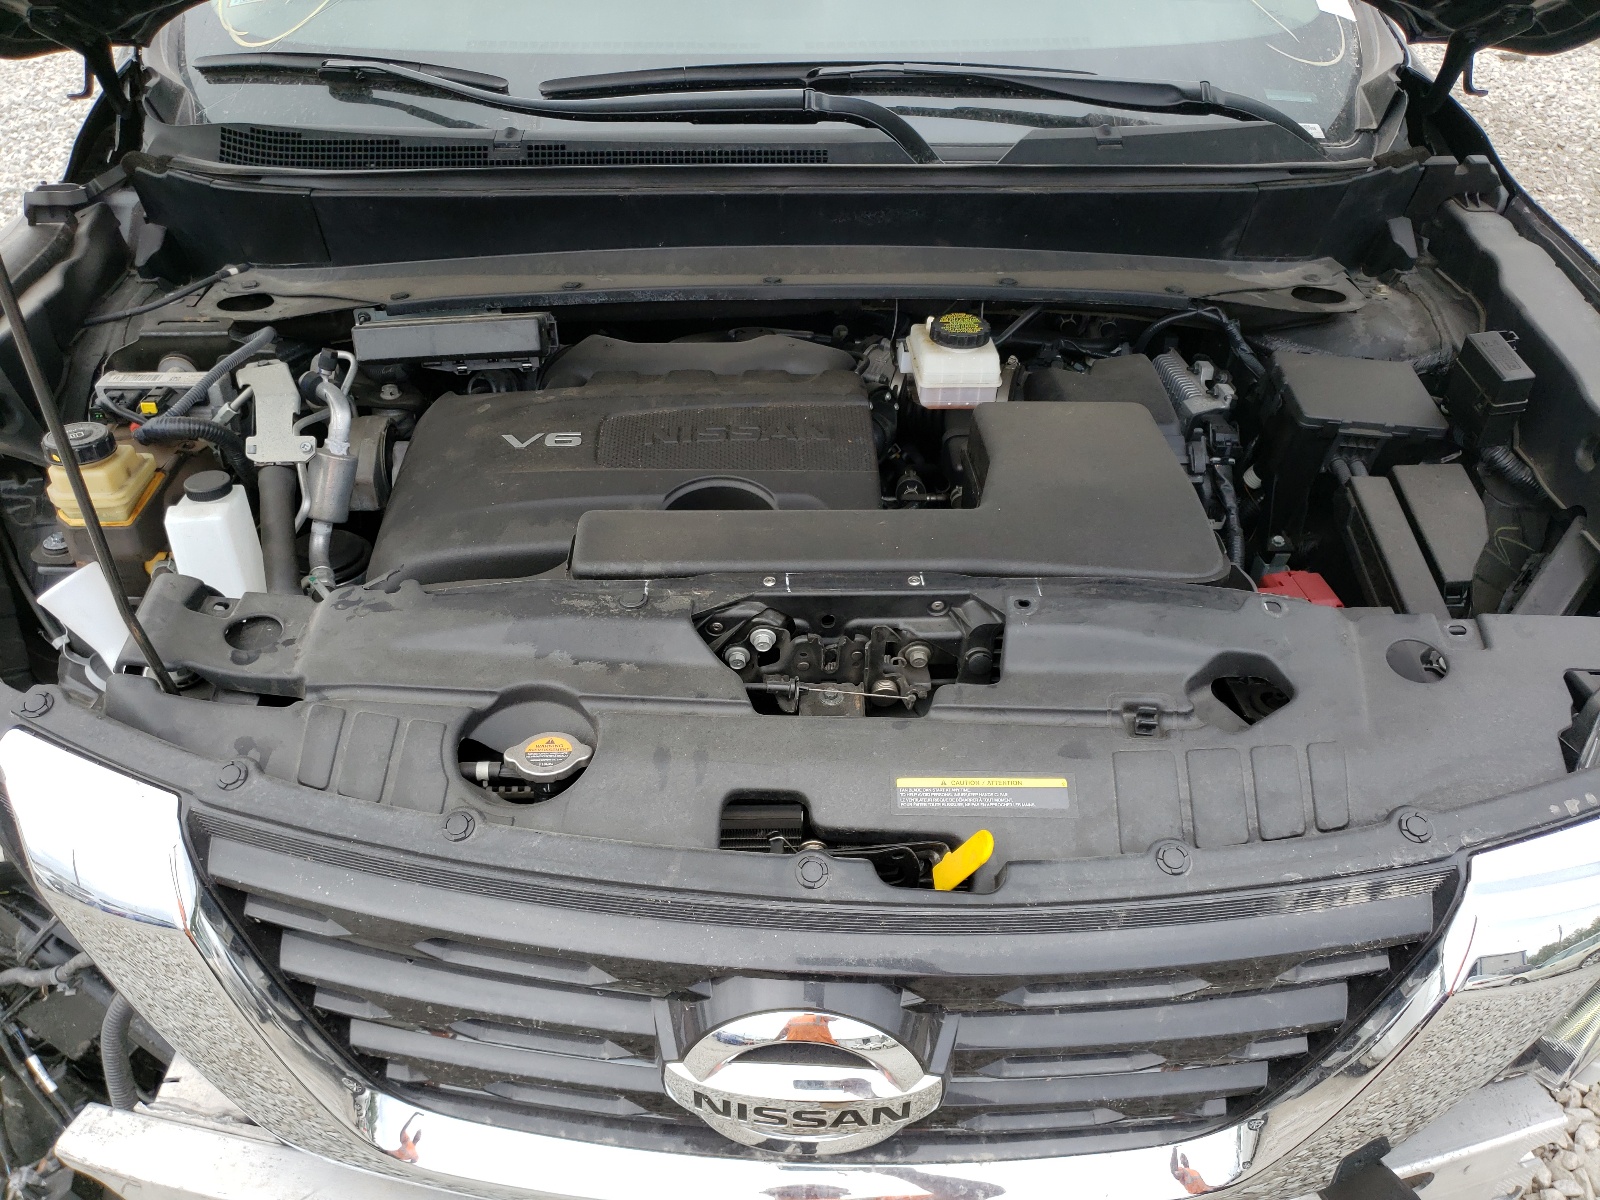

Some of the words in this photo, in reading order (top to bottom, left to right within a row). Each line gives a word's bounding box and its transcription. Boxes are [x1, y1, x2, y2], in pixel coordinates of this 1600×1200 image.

[501, 431, 582, 449] V6
[643, 425, 832, 447] NISSAN
[693, 1090, 912, 1129] NISSAN
